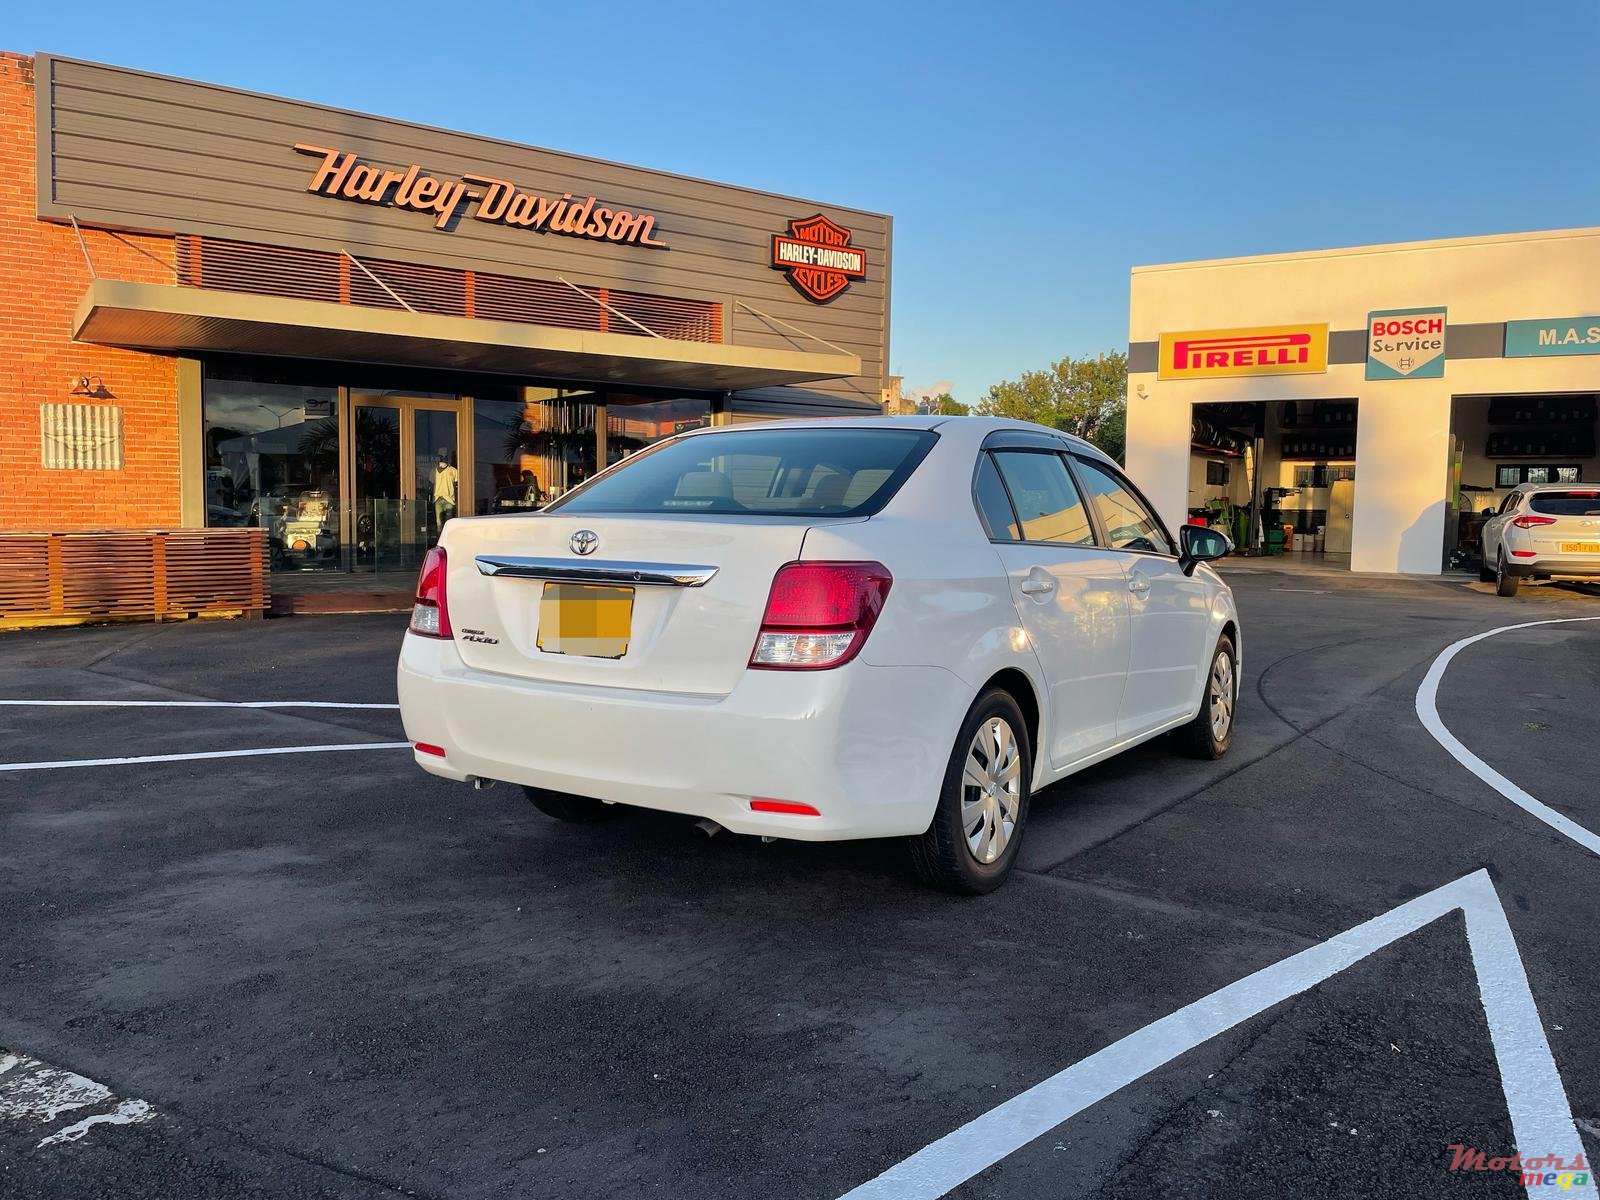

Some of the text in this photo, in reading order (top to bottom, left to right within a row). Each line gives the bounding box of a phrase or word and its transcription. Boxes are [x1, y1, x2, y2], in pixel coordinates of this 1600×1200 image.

[293, 143, 667, 247] Harley-Davidson
[800, 222, 844, 246] MOTOR
[779, 241, 861, 272] HARLEY-DAVIDSON
[799, 268, 845, 295] CYCLES
[1373, 318, 1443, 337] BOSCH
[1173, 333, 1312, 370] PIRELLI
[1373, 337, 1442, 353] Service
